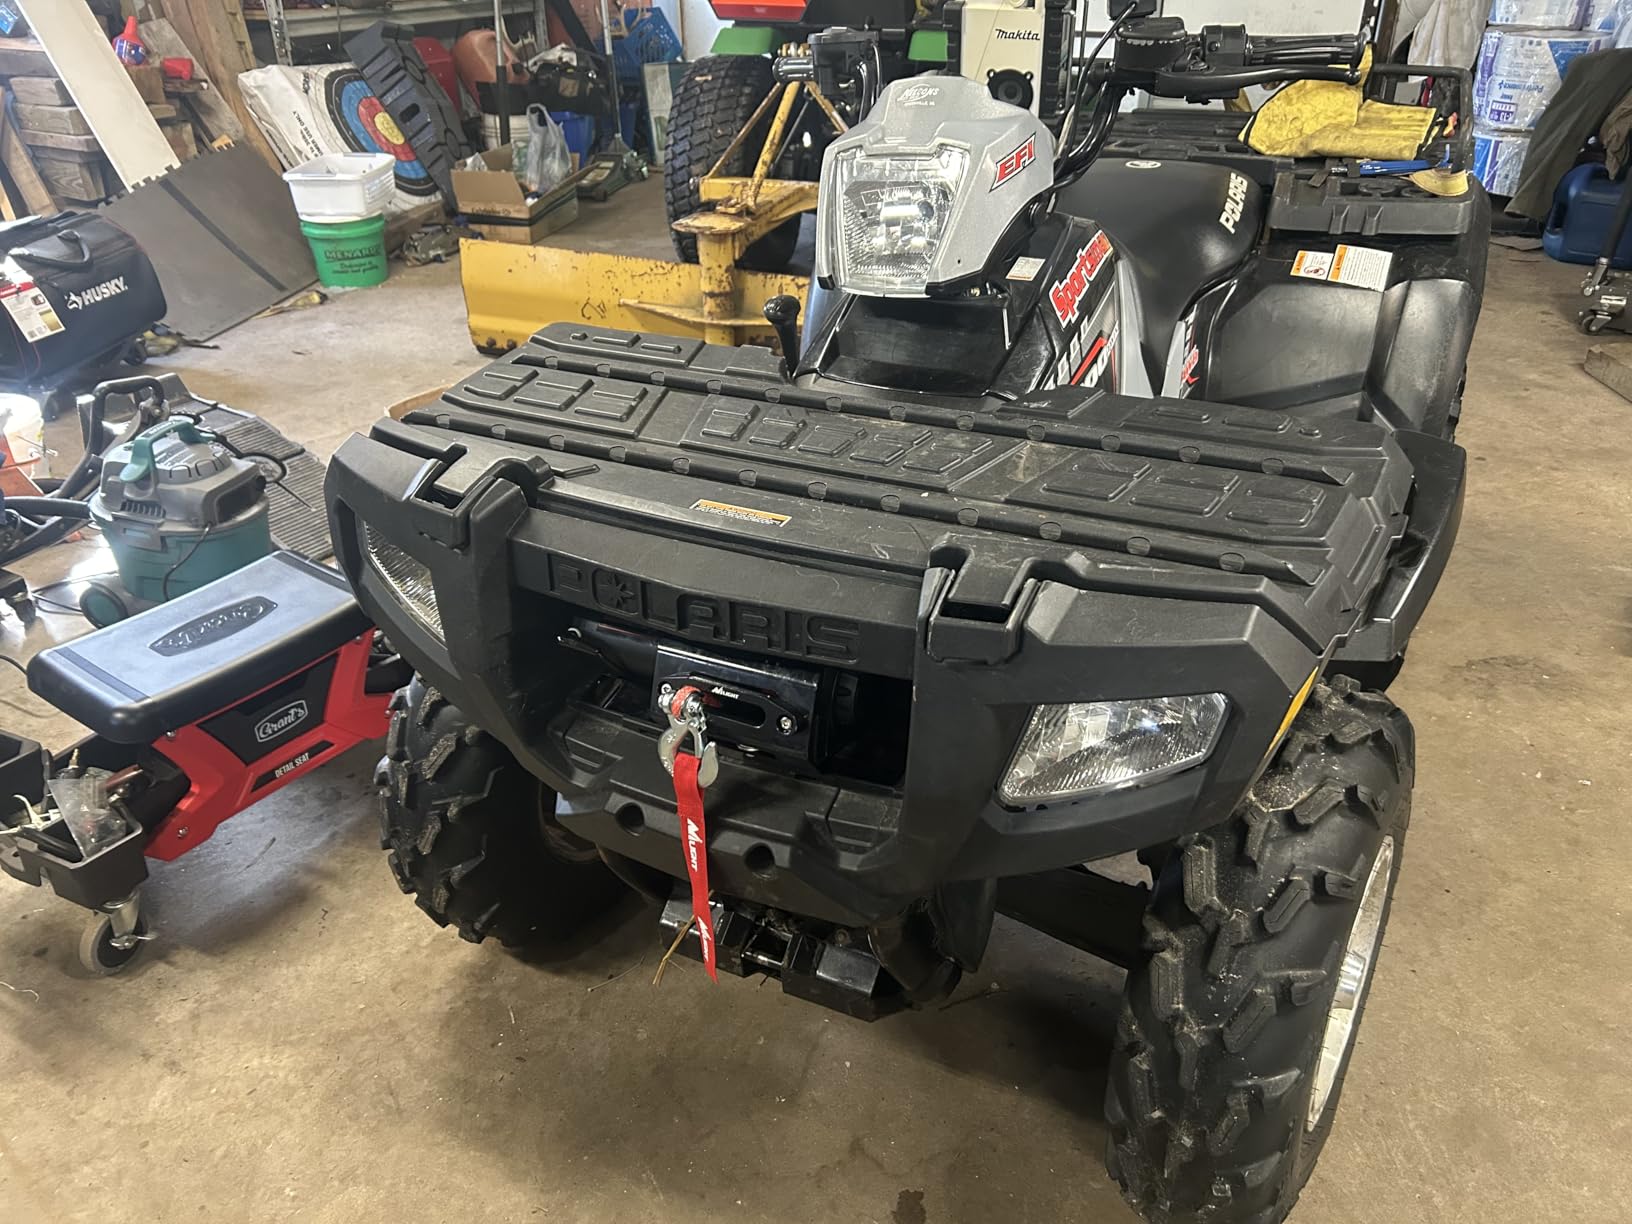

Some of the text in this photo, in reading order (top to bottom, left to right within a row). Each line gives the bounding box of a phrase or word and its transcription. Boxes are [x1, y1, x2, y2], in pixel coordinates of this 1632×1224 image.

[995, 28, 1041, 41] Makita
[995, 138, 1035, 187] EFI
[1219, 172, 1248, 234] POLARIS
[547, 553, 860, 665] POLARIS
[259, 707, 305, 738] Grant's
[274, 752, 310, 778] DETAIL SEAT
